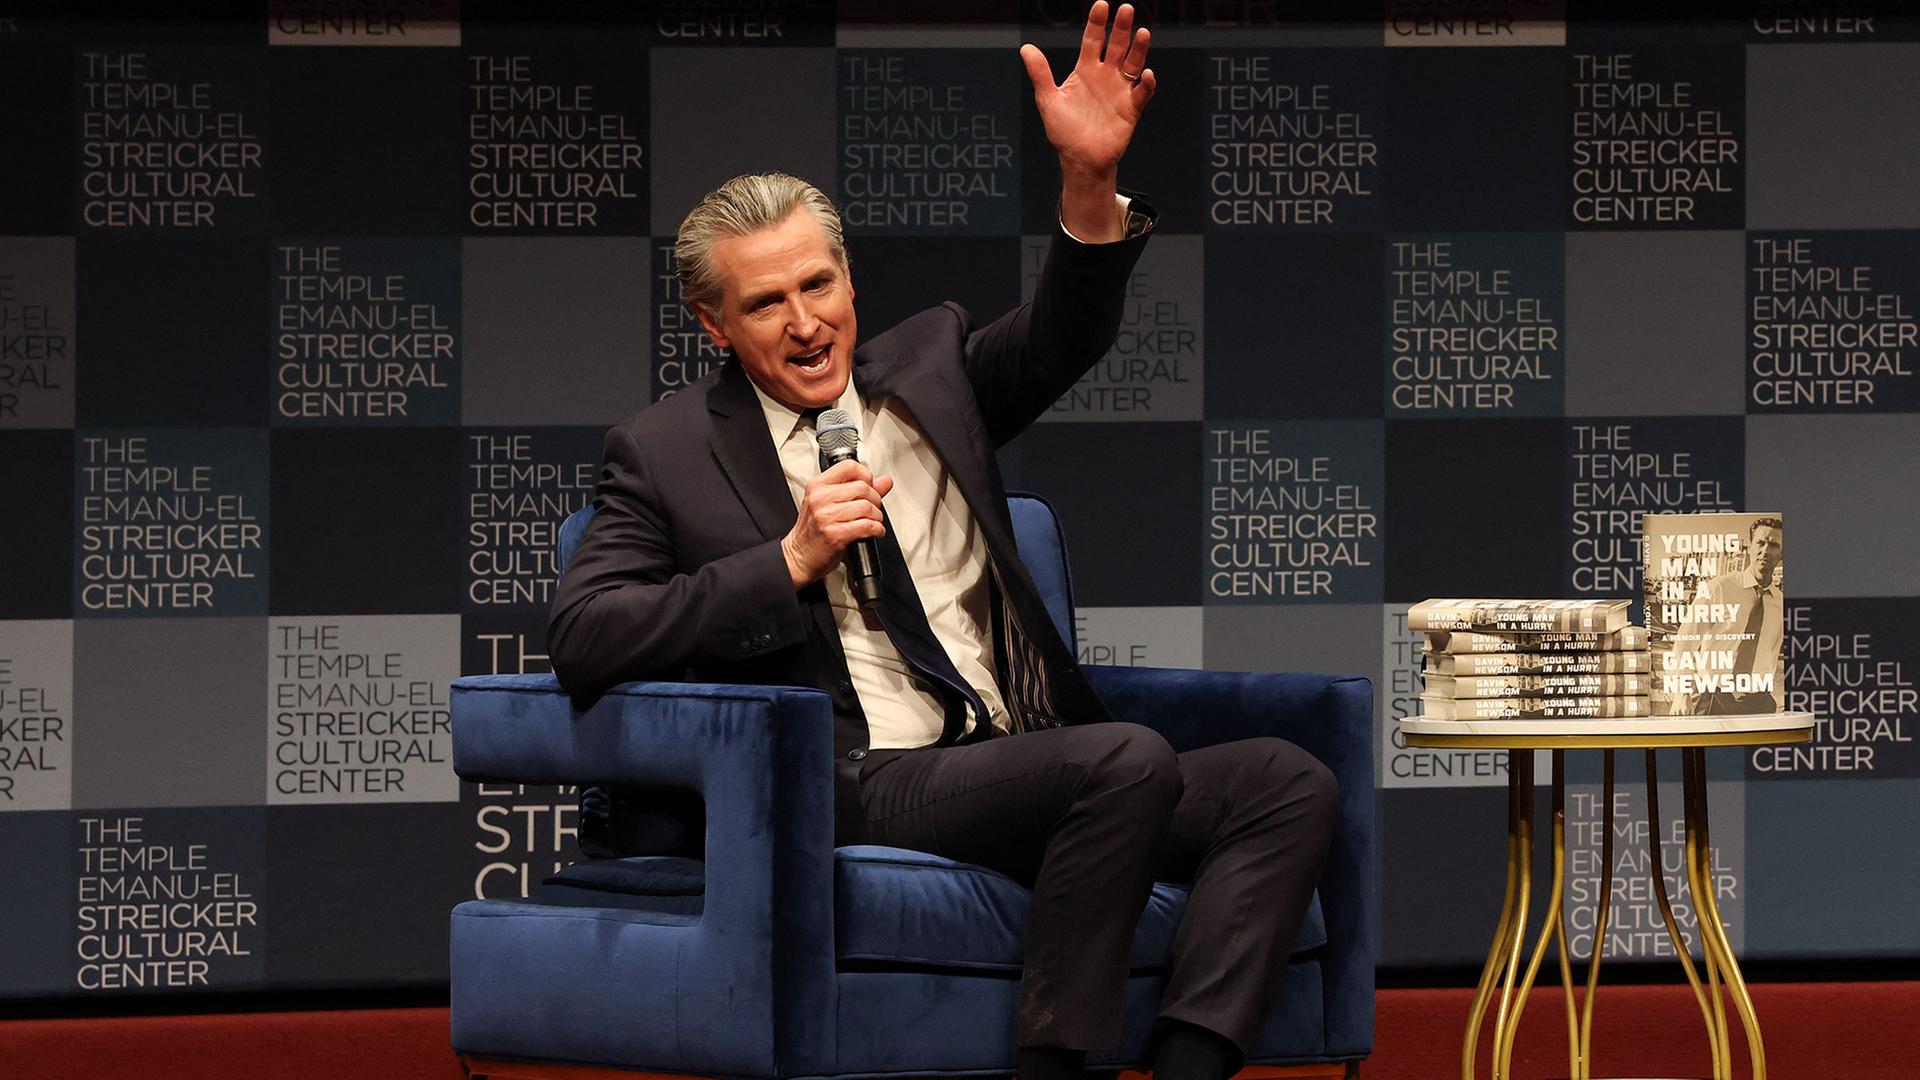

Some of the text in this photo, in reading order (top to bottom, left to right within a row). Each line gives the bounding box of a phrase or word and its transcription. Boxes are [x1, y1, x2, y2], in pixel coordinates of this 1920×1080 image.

[278, 10, 406, 35] CENTER
[657, 13, 784, 38] CENTER
[1393, 11, 1513, 36] CENTER
[1753, 9, 1874, 34] CENTER
[83, 53, 146, 79] THE
[470, 56, 530, 81] THE
[845, 57, 903, 82] THE
[1211, 57, 1270, 81] THE
[1574, 55, 1631, 79] THE
[84, 83, 210, 109] TEMPLE
[470, 85, 592, 111] TEMPLE
[845, 86, 964, 111] TEMPLE
[1212, 85, 1329, 110] TEMPLE
[1574, 83, 1691, 108] TEMPLE
[84, 113, 256, 139] EMANU-EL
[471, 114, 636, 140] EMANU-EL
[845, 115, 1006, 140] EMANU-EL
[1212, 114, 1371, 139] EMANU-EL
[1574, 111, 1732, 136] EMANU-EL
[84, 142, 261, 167] STREICKER
[471, 144, 642, 168] STREICKER
[845, 144, 1012, 168] STREICKER
[1212, 142, 1377, 167] STREICKER
[1574, 139, 1737, 165] STREICKER
[84, 172, 255, 197] CULTURAL
[470, 173, 636, 198] CULTURAL
[845, 173, 1007, 197] CULTURAL
[1211, 171, 1371, 196] CULTURAL
[1573, 168, 1732, 193] CULTURAL
[84, 201, 214, 226] CENTER
[470, 202, 596, 226] CENTER
[845, 202, 968, 226] CENTER
[1211, 200, 1333, 224] CENTER
[1573, 197, 1694, 221] CENTER
[279, 247, 340, 272] THE
[1393, 243, 1451, 267] THE
[1754, 239, 1811, 263] THE
[280, 276, 404, 301] TEMPLE
[1393, 270, 1510, 295] TEMPLE
[1753, 267, 1870, 292] TEMPLE
[280, 305, 448, 330] EMANU-EL
[1393, 299, 1552, 324] EMANU-EL
[1754, 295, 1912, 320] EMANU-EL
[280, 334, 453, 358] STREICKER
[1393, 327, 1557, 352] STREICKER
[1754, 323, 1917, 348] STREICKER
[279, 363, 447, 388] CULTURAL
[1080, 358, 1190, 383] TURAL
[1393, 355, 1551, 380] CULTURAL
[1753, 352, 1911, 377] CULTURAL
[279, 392, 407, 417] CENTER
[1052, 388, 1151, 412] ENTER
[1392, 384, 1513, 408] CENTER
[1753, 380, 1873, 405] CENTER
[470, 436, 532, 460] THE
[1211, 430, 1269, 454] THE
[1572, 425, 1631, 450] THE
[84, 438, 146, 463] THE
[470, 464, 594, 489] TEMPLE
[1211, 457, 1329, 483] TEMPLE
[1572, 453, 1690, 479] TEMPLE
[84, 467, 210, 492] TEMPLE
[1212, 485, 1371, 511] EMANU-EL
[1573, 481, 1732, 507] EMANU-EL
[84, 495, 255, 521] EMANU-EL
[83, 524, 261, 550] STREICKER
[470, 521, 556, 546] STREI
[1211, 514, 1376, 539] STREICKER
[1211, 542, 1370, 568] CULTURAL
[1661, 534, 1739, 553] YOUNG
[83, 554, 254, 580] CULTURAL
[1661, 557, 1717, 576] MAN
[82, 583, 213, 609] CENTER
[469, 579, 559, 604] CENT
[1211, 571, 1332, 596] CENTER
[1662, 581, 1711, 600] IN A
[1428, 613, 1456, 621] GAVIN
[1497, 613, 1555, 622] YOUNG MAN
[1662, 603, 1740, 623] HURRY
[1784, 607, 1811, 632] HE
[278, 626, 338, 650] THE
[1428, 622, 1472, 630] NEWSOM
[1497, 622, 1552, 630] IN A HURRY
[1541, 633, 1597, 641] YOUNG MAN
[1671, 633, 1699, 641] MEMOIR
[1715, 633, 1756, 641] DISCOVERY
[1472, 635, 1500, 643] GAVIN
[1472, 643, 1516, 651] NEWSOM
[1541, 642, 1596, 650] IN A HURRY
[277, 653, 401, 679] TEMPLE
[1475, 657, 1503, 665] GAVIN
[1475, 666, 1518, 674] NEWSOM
[1543, 656, 1600, 664] YOUNG MAN
[1567, 664, 1598, 672] HURRY
[1663, 651, 1733, 670] GAVIN
[1476, 679, 1505, 687] GAVIN
[1476, 688, 1520, 696] NEWSOM
[1544, 677, 1601, 686] YOUNG MAN
[1544, 686, 1599, 694] IN A HURRY
[1663, 673, 1773, 693] NEWSOM
[278, 682, 445, 708] EMANU-EL
[1476, 700, 1505, 708] GAVIN
[1544, 699, 1601, 707] YOUNG MAN
[1784, 690, 1918, 715] REICKER
[277, 711, 451, 737] STREICKER
[1476, 709, 1520, 717] NEWSOM
[1544, 708, 1599, 716] IN A HURRY
[1814, 717, 1912, 743] TURAL
[276, 740, 444, 765] CULTURAL
[1391, 752, 1509, 778] CENTER
[1752, 746, 1875, 772] CENTER
[276, 768, 404, 794] CENTER
[80, 818, 142, 843] THE
[79, 845, 206, 872] TEMPLE
[79, 873, 251, 902] EMANU-EL
[78, 902, 257, 931] STREICKER
[78, 931, 250, 960] CULTURAL
[78, 961, 208, 989] CENTER
